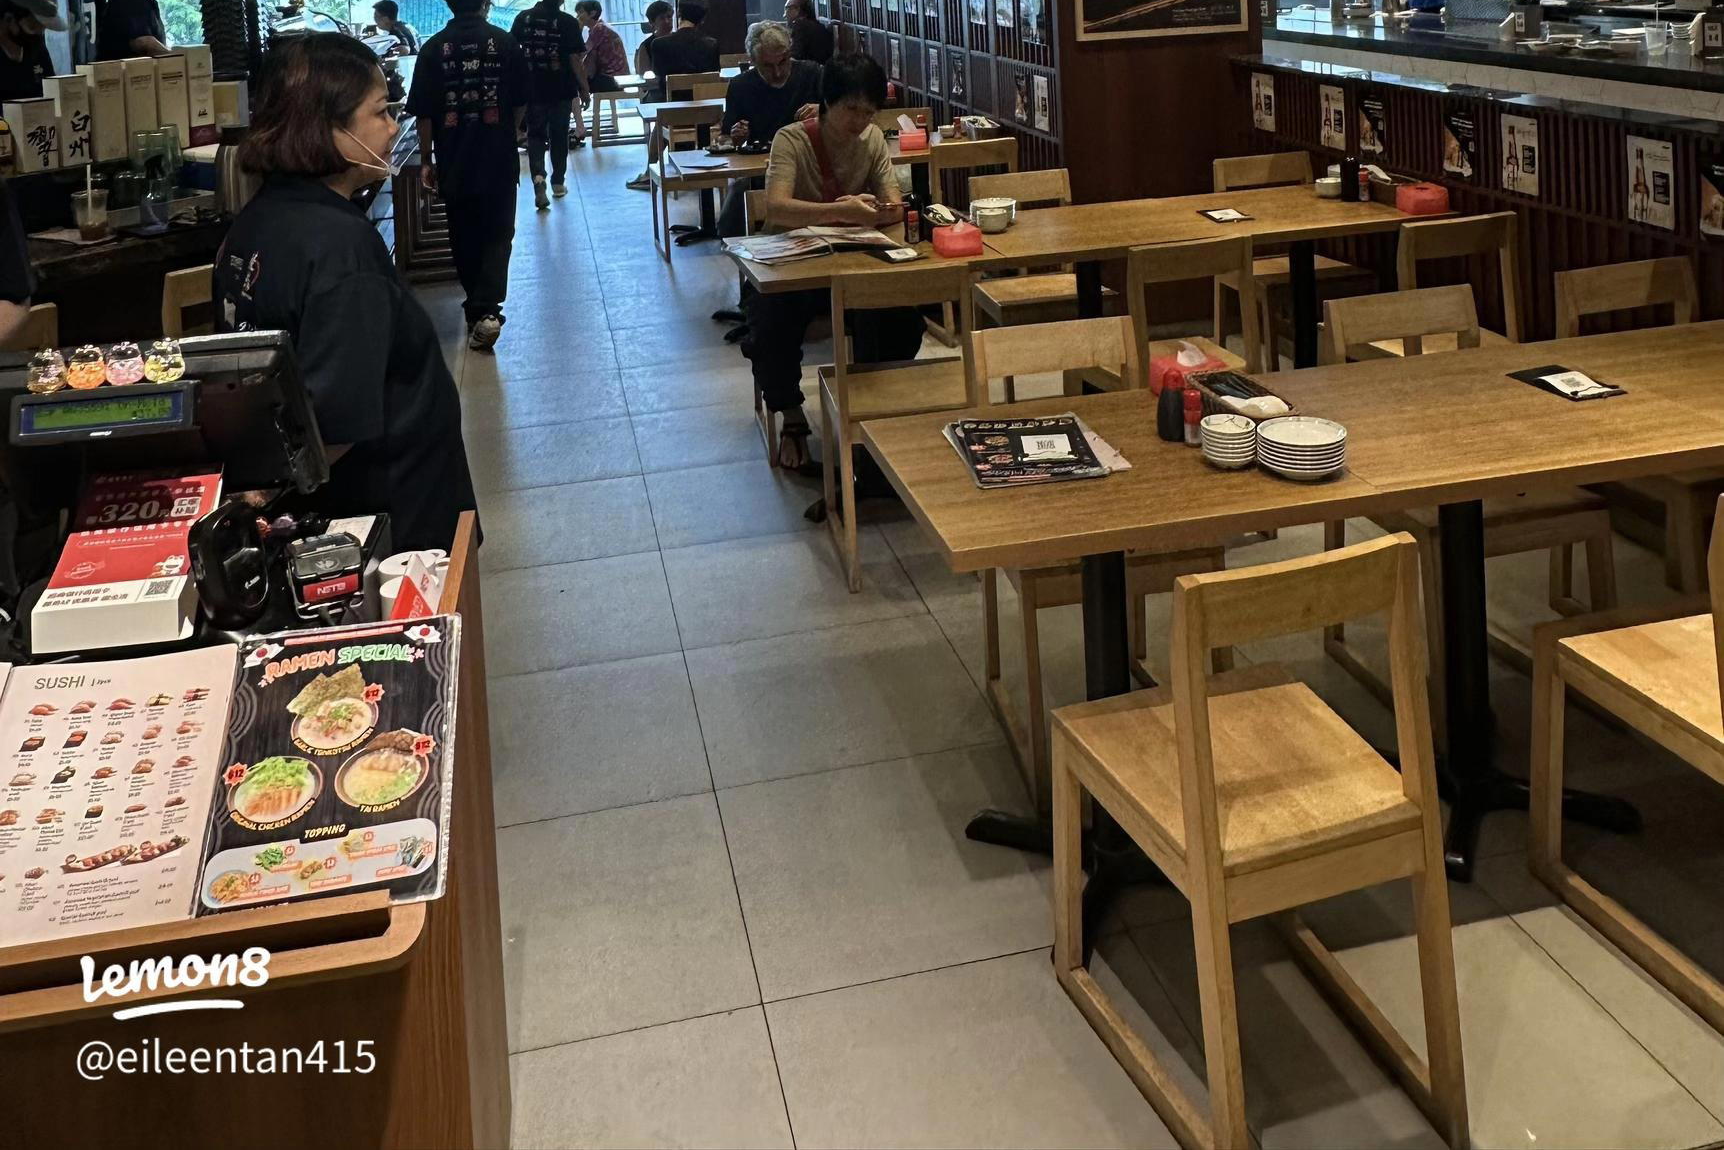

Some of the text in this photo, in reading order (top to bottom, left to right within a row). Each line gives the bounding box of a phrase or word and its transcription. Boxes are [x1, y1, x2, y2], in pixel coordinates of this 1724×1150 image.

[264, 643, 412, 679] RAMEN SPECIAL
[34, 675, 85, 690] SUSHI
